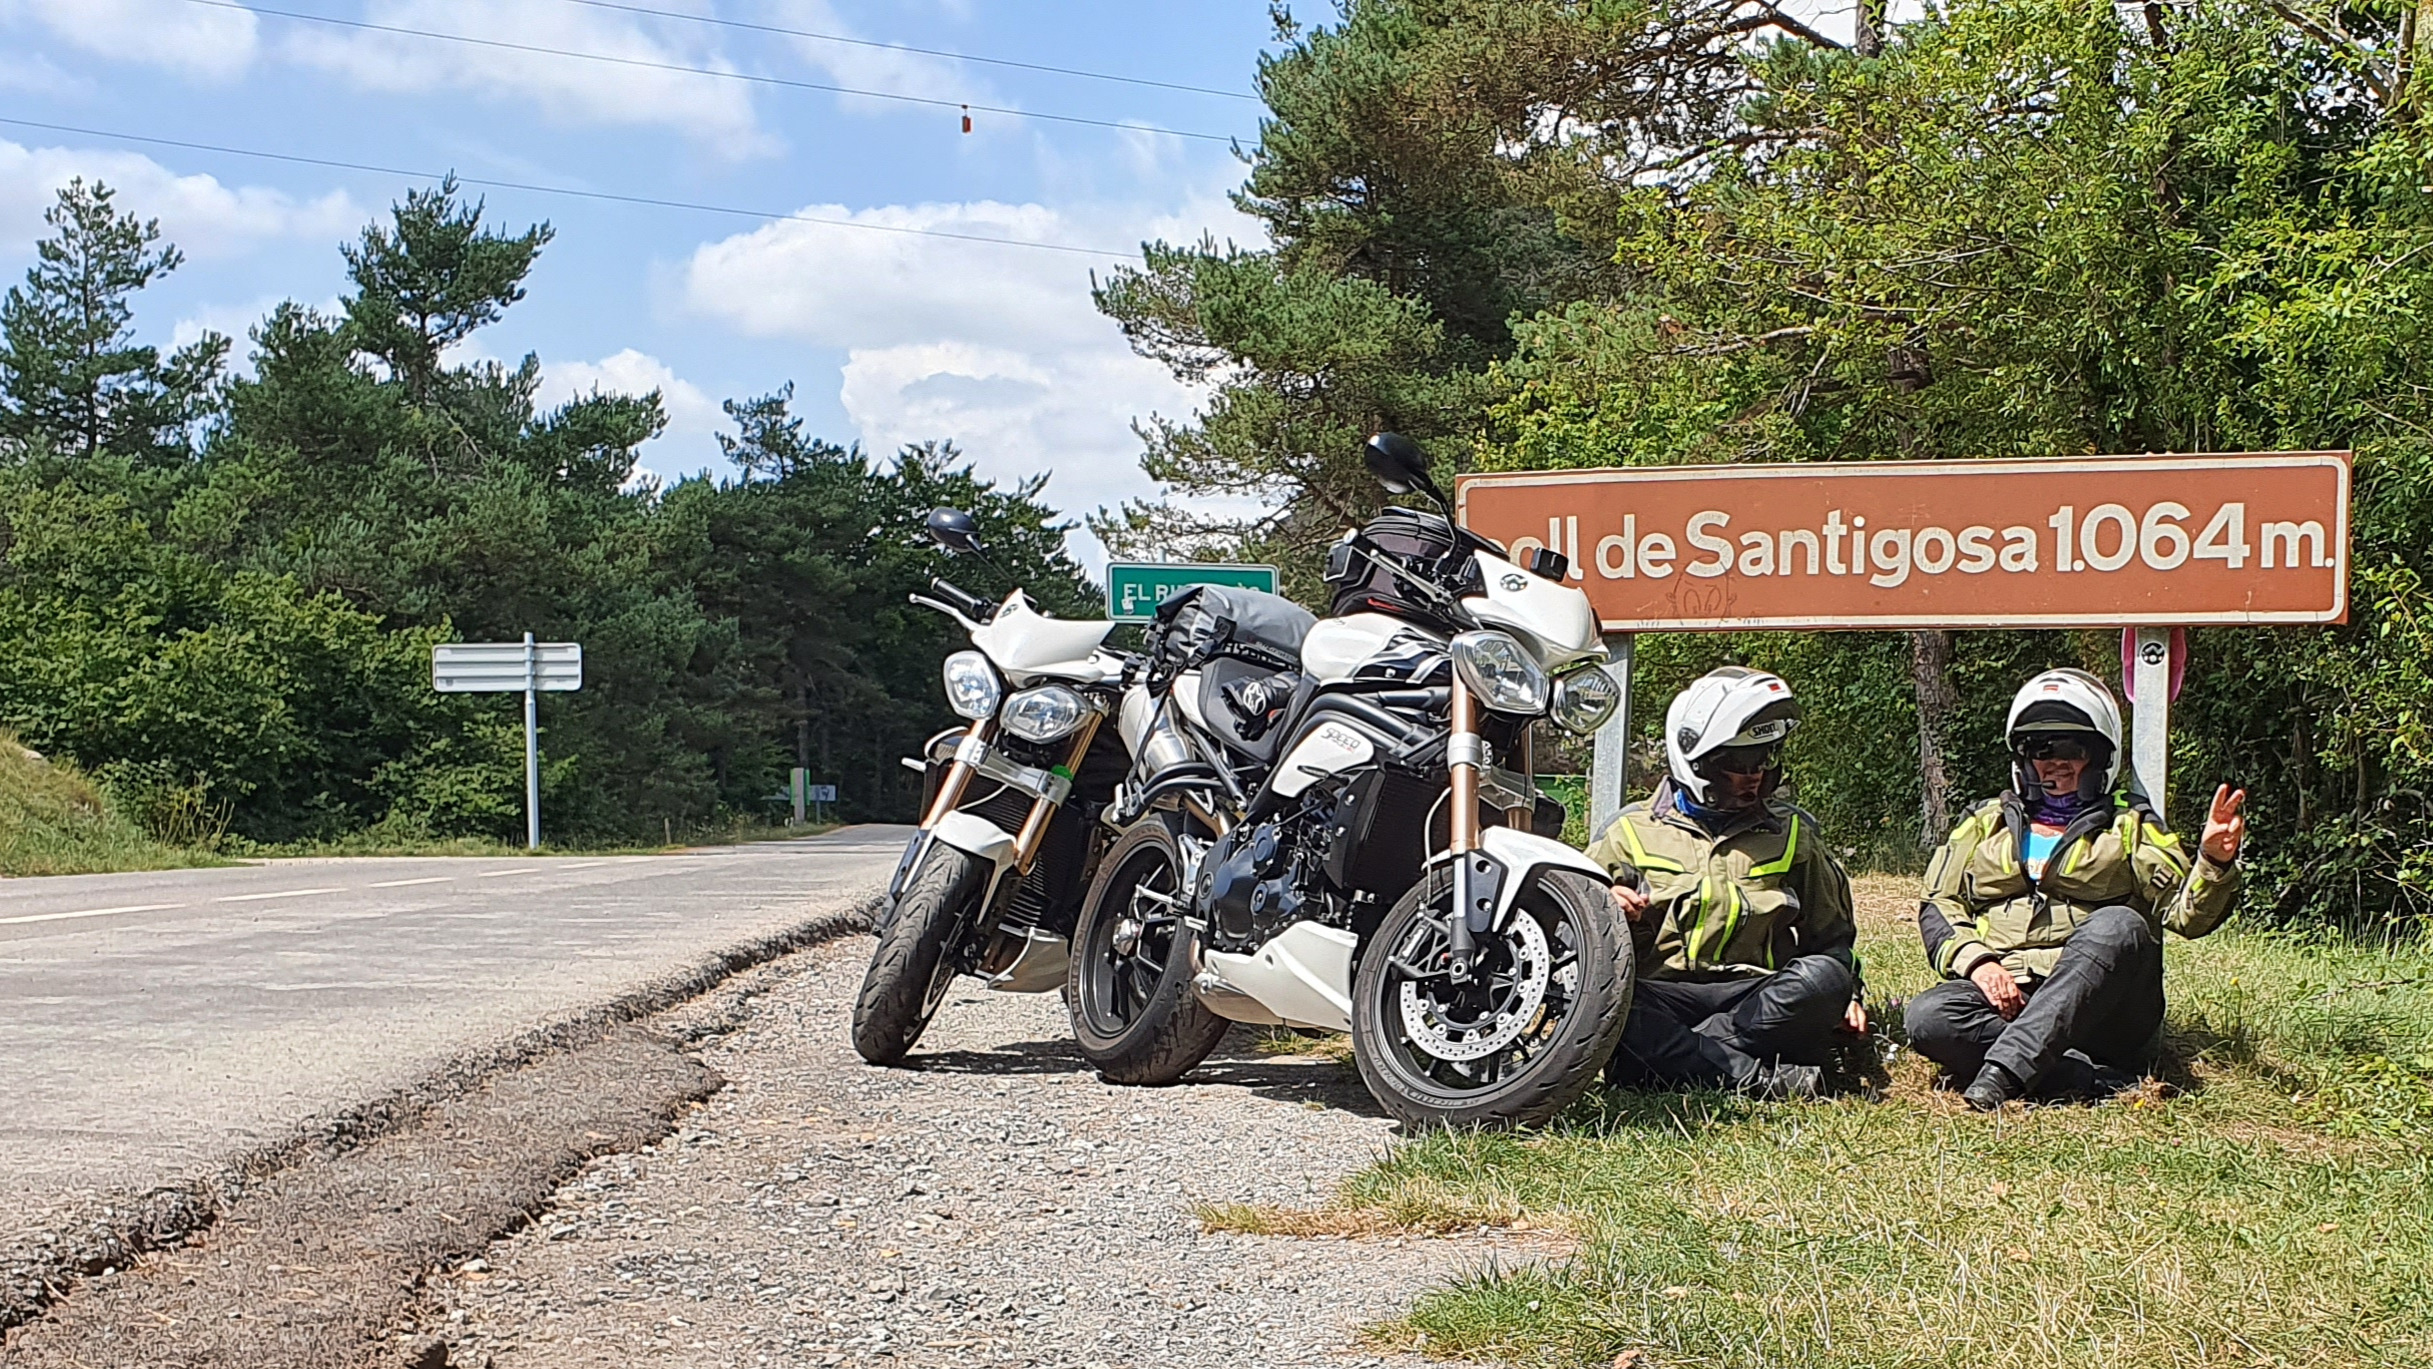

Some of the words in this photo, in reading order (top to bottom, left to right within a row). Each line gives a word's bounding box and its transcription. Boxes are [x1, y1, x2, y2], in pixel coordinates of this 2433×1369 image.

[1487, 514, 1584, 580] oll
[1595, 513, 1677, 579] de
[1685, 509, 2039, 588] Santigosa
[2048, 501, 2251, 572] 1.064
[2260, 520, 2335, 569] m.
[1123, 583, 1151, 601] EL
[1071, 941, 1084, 1013] MICHELIN
